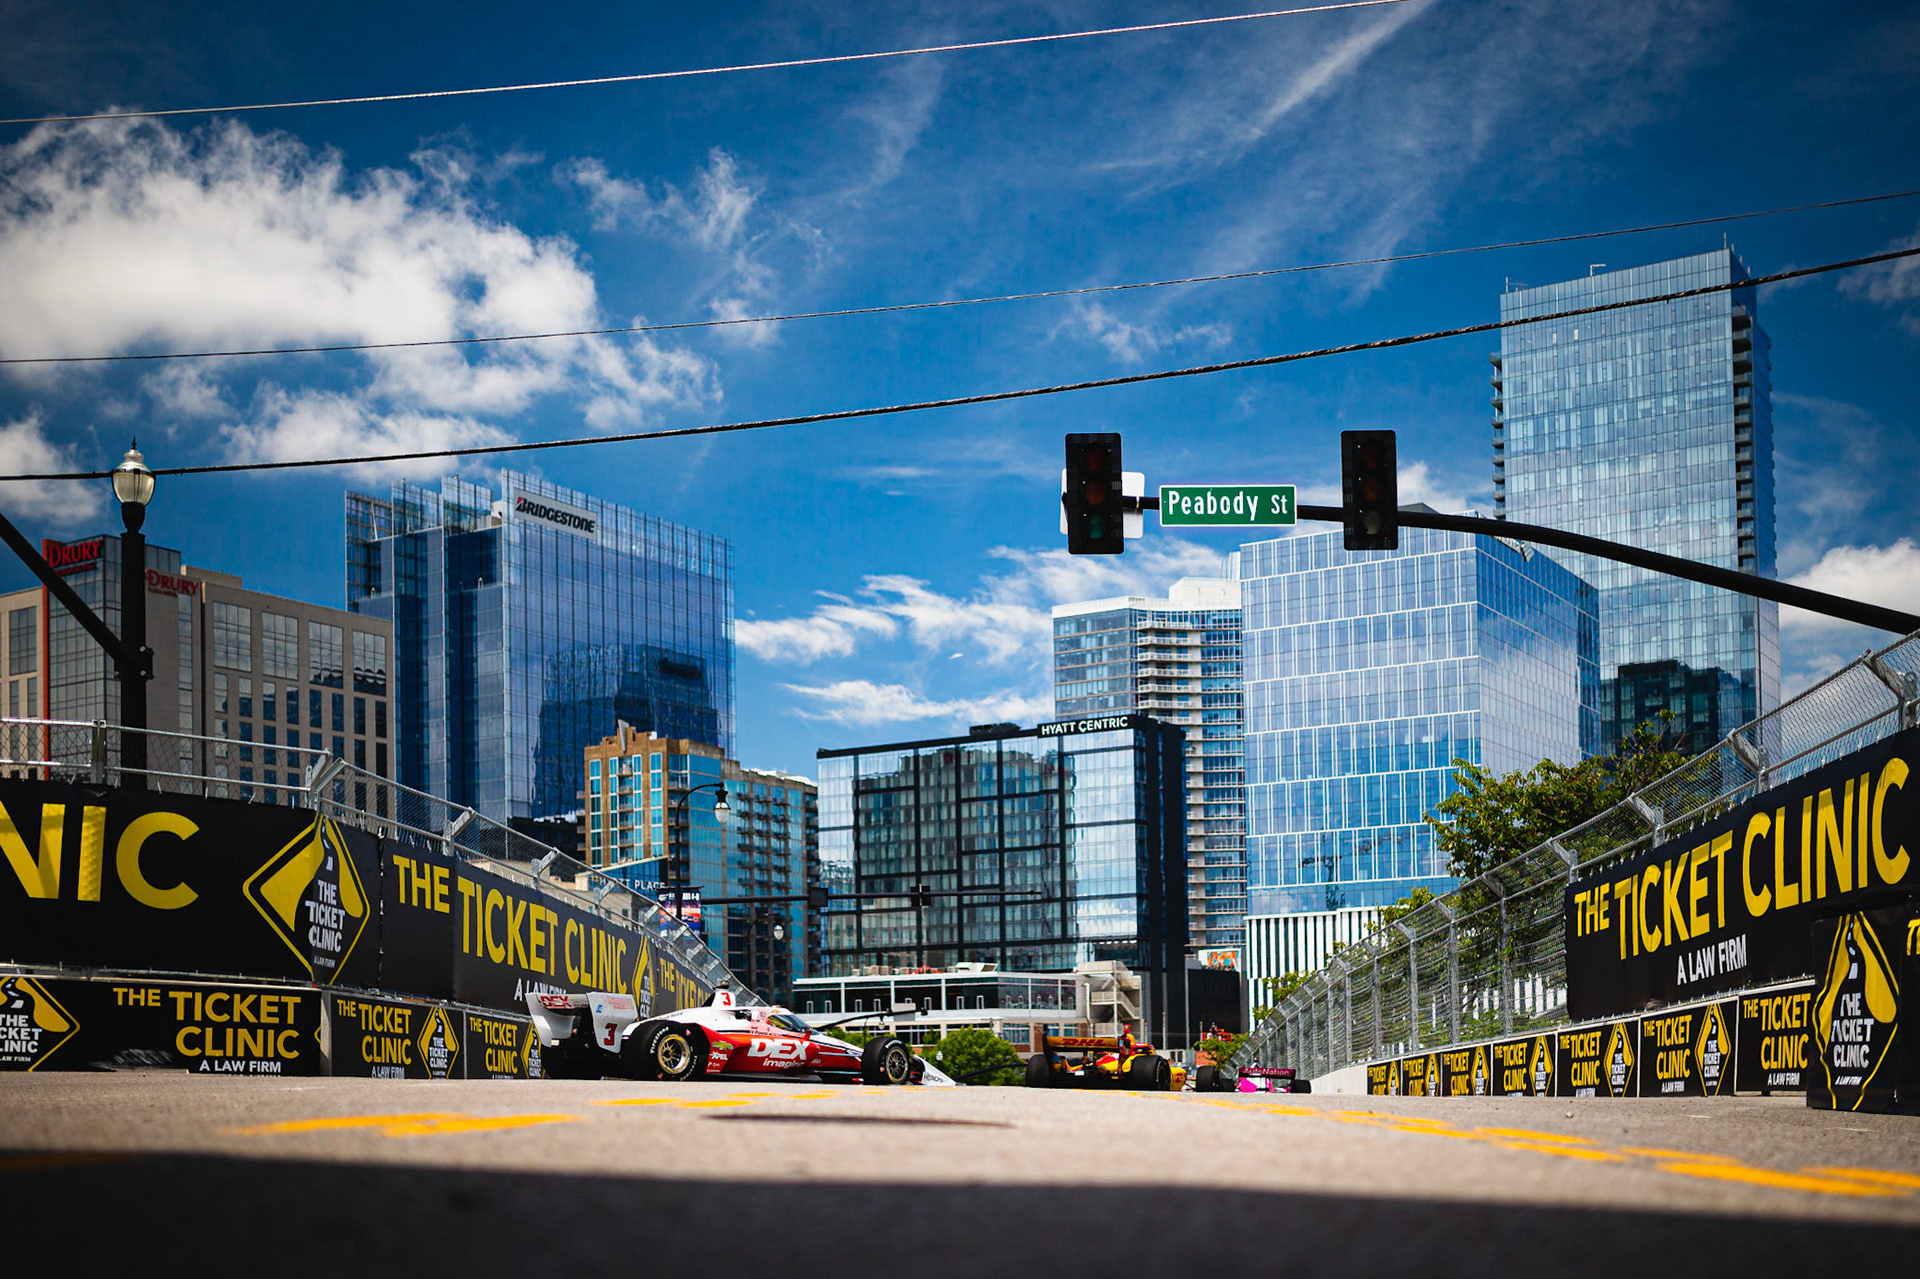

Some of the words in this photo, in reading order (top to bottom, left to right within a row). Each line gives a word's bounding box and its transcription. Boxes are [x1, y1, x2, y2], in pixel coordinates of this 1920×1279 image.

[515, 498, 595, 533] BRIDGESTONE
[1168, 490, 1258, 521] Peabody
[1270, 494, 1288, 514] St
[49, 539, 101, 568] DRURY
[147, 568, 198, 595] DRURY
[1042, 722, 1076, 735] HYATT
[1078, 716, 1128, 732] CENTRIC
[1574, 882, 1609, 937] THE
[1614, 829, 1733, 960] TICKET
[1742, 757, 1911, 918] CLINIC
[318, 879, 337, 905] THE
[305, 900, 345, 930] TICKET
[393, 854, 450, 914] THE
[457, 875, 558, 976] TICKET
[564, 918, 627, 994] CLINIC
[308, 925, 342, 952] CLINIC
[1677, 955, 1687, 986] A
[1688, 944, 1715, 982] LAW
[1718, 933, 1747, 974] FIRM
[660, 957, 675, 993] THE
[514, 978, 523, 1002] A
[721, 992, 731, 1006] 3
[113, 987, 161, 1007] THE
[168, 991, 301, 1024] TICKET
[337, 999, 357, 1018] THE
[358, 1003, 412, 1034] TICKET
[1743, 998, 1759, 1019] THE
[1760, 992, 1811, 1031] TICKET
[1840, 992, 1861, 1017] THE
[175, 1025, 299, 1059] CLINIC
[432, 1036, 444, 1048] THE
[469, 1016, 482, 1032] THE
[483, 1020, 518, 1047] TICKET
[604, 1023, 617, 1046] 3
[1061, 1038, 1107, 1046] DHL
[1643, 1020, 1655, 1037] THE
[1655, 1014, 1692, 1047] TICKET
[1830, 1018, 1875, 1043] TICKET
[362, 1035, 412, 1065] CLINIC
[429, 1047, 448, 1058] TICKET
[747, 1038, 809, 1060] DEX
[1494, 1045, 1503, 1058] THE
[1503, 1042, 1528, 1067] TICKET
[1560, 1035, 1570, 1049] THE
[1570, 1031, 1602, 1059] TICKET
[1704, 1052, 1721, 1065] TICKET
[1707, 1040, 1718, 1053] THE
[1760, 1033, 1809, 1070] CLINIC
[1833, 1044, 1870, 1069] CLINIC
[200, 1060, 210, 1071] A
[214, 1060, 245, 1072] LAW
[250, 1061, 281, 1073] FIRM
[430, 1058, 447, 1068] CLINIC
[485, 1047, 518, 1074] CLINIC
[1243, 1067, 1289, 1076] AutoNation
[1571, 1060, 1600, 1087] CLINIC
[1656, 1048, 1691, 1080] CLINIC
[1704, 1064, 1720, 1078] CLINIC
[1503, 1067, 1527, 1091] CLINIC
[1767, 1074, 1773, 1086] A
[1773, 1073, 1786, 1086] LAW
[1786, 1072, 1800, 1086] FIRM
